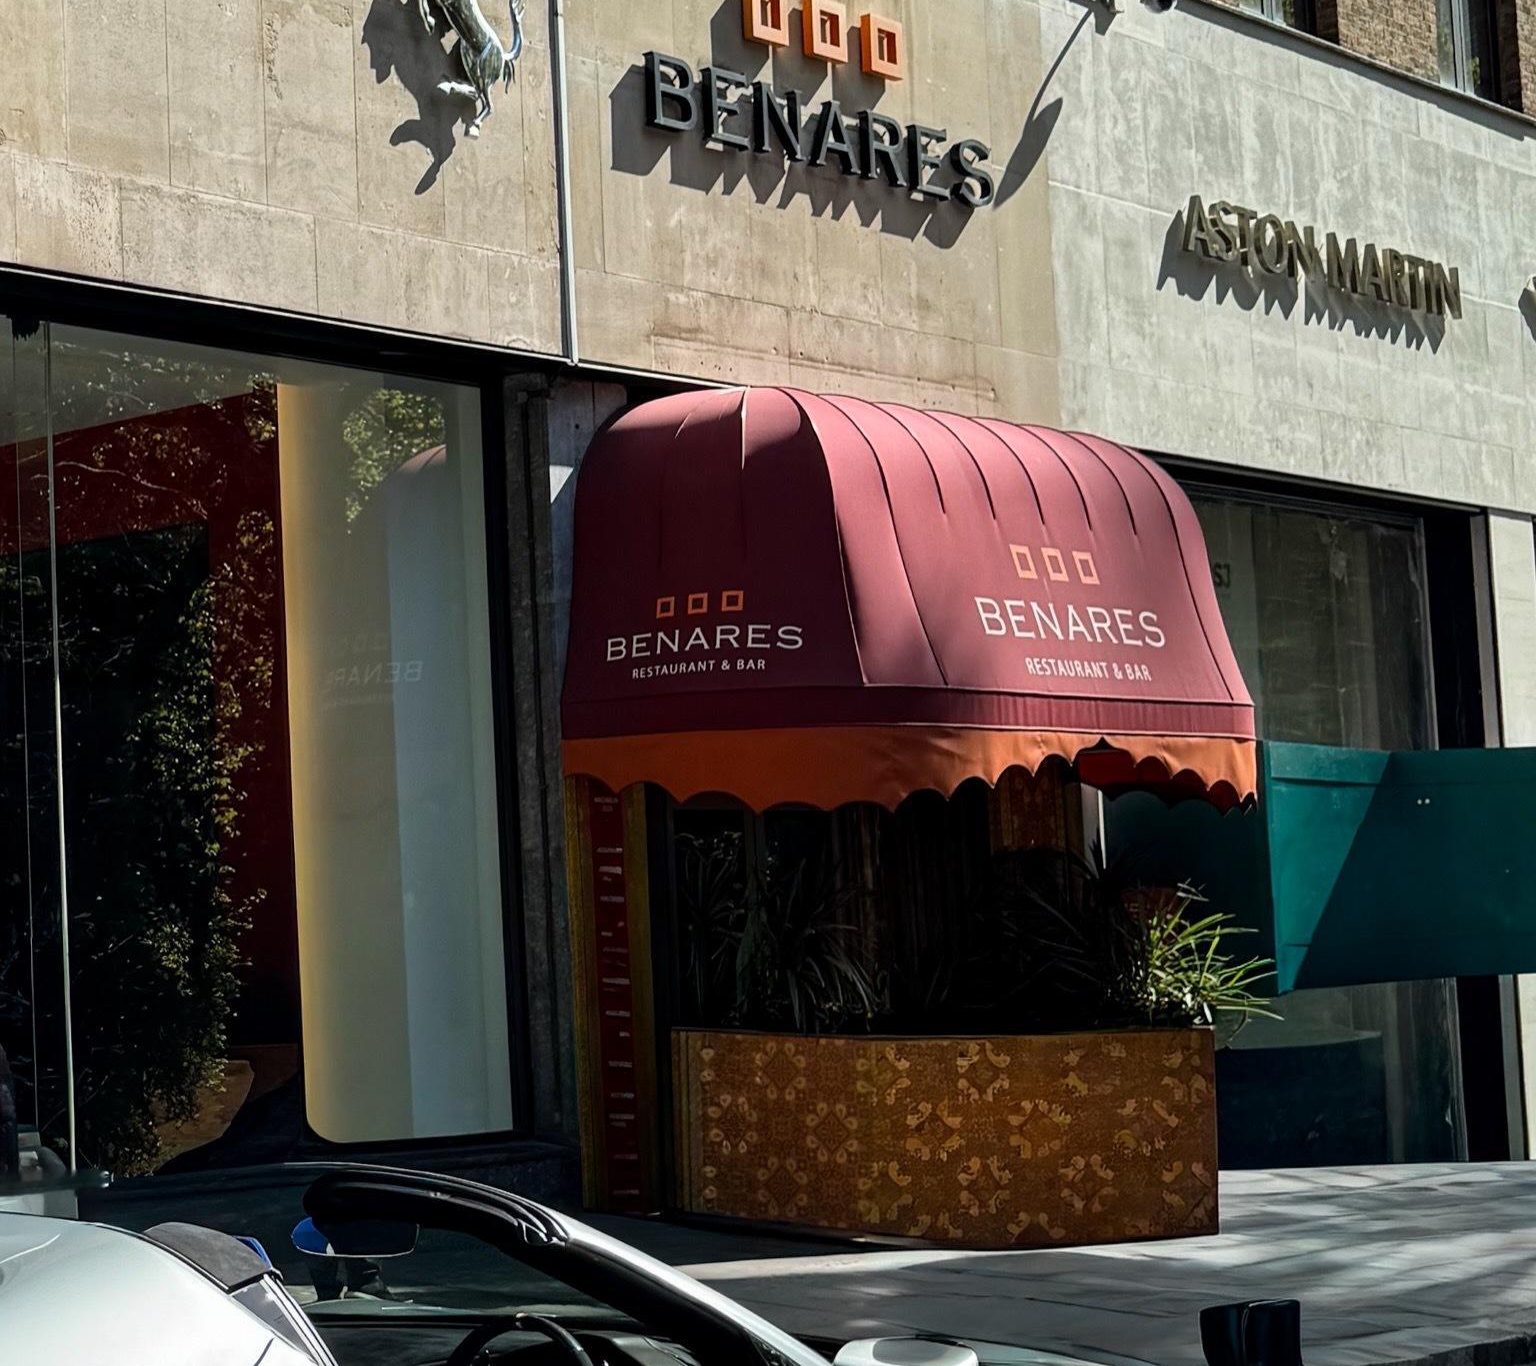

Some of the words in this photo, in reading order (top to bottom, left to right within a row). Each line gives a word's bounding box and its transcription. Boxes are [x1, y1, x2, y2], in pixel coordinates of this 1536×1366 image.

[643, 50, 995, 210] BENARES
[1182, 195, 1317, 280] ASTON
[1326, 231, 1462, 320] MARTIN
[606, 624, 804, 662] BENARES
[974, 596, 1166, 649] BENARES
[631, 659, 716, 680] RESTAURANT
[721, 659, 731, 671] &
[736, 658, 766, 671] BAR
[1024, 657, 1110, 680] RESTAURANT
[1112, 662, 1123, 680] &
[1124, 663, 1152, 682] BAR
